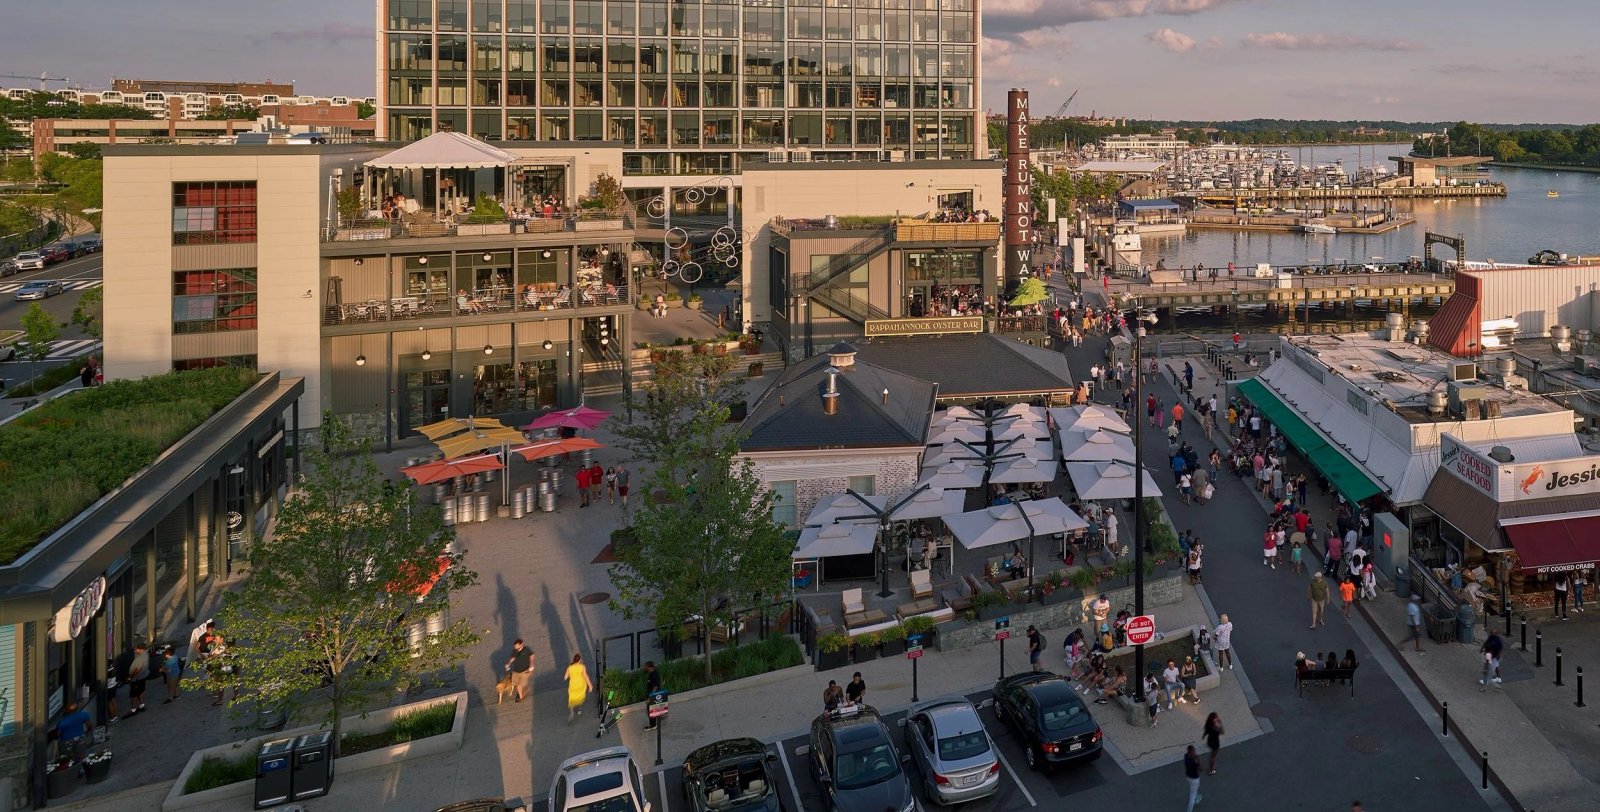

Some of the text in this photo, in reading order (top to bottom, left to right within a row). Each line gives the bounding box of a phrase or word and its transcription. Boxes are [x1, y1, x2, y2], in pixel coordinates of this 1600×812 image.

[1016, 98, 1028, 149] MAKE
[1017, 159, 1029, 195] RUM
[1017, 201, 1029, 242] NOT
[869, 319, 979, 332] RAPPAHANNOCK OYSTER BAR
[1456, 462, 1491, 492] SEAFOOD
[1460, 450, 1491, 477] COOKED
[1550, 564, 1575, 572] COOKED
[1575, 562, 1595, 570] CRABS
